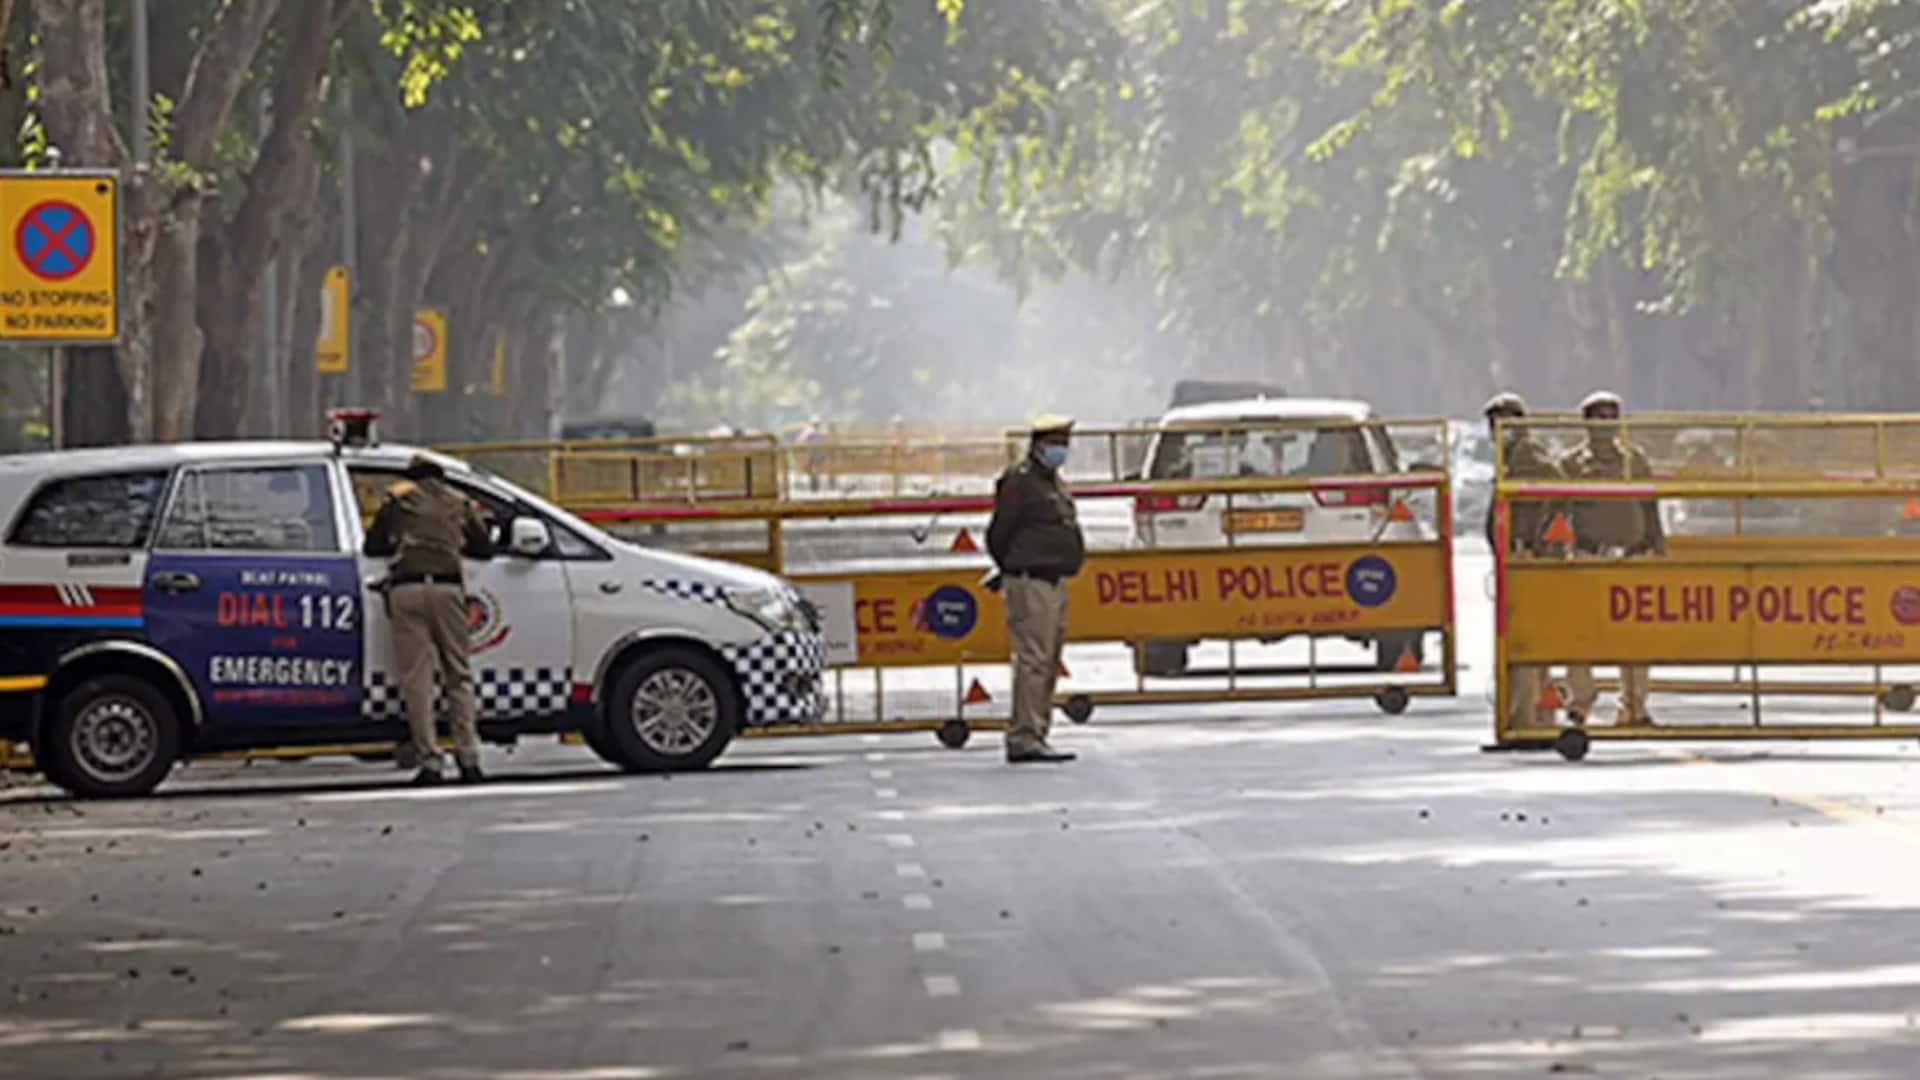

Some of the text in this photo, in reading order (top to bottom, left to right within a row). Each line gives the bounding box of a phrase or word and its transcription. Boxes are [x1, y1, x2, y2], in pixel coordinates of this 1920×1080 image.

[0, 289, 111, 307] NO STOPPING
[6, 313, 106, 330] NO PARKING
[1096, 571, 1198, 605] DELHI
[1216, 563, 1344, 600] POLICE
[216, 591, 353, 630] DIAL 112
[1609, 586, 1714, 623] DELHI
[1729, 586, 1866, 625] POLICE
[209, 655, 352, 686] EMERGENCY
